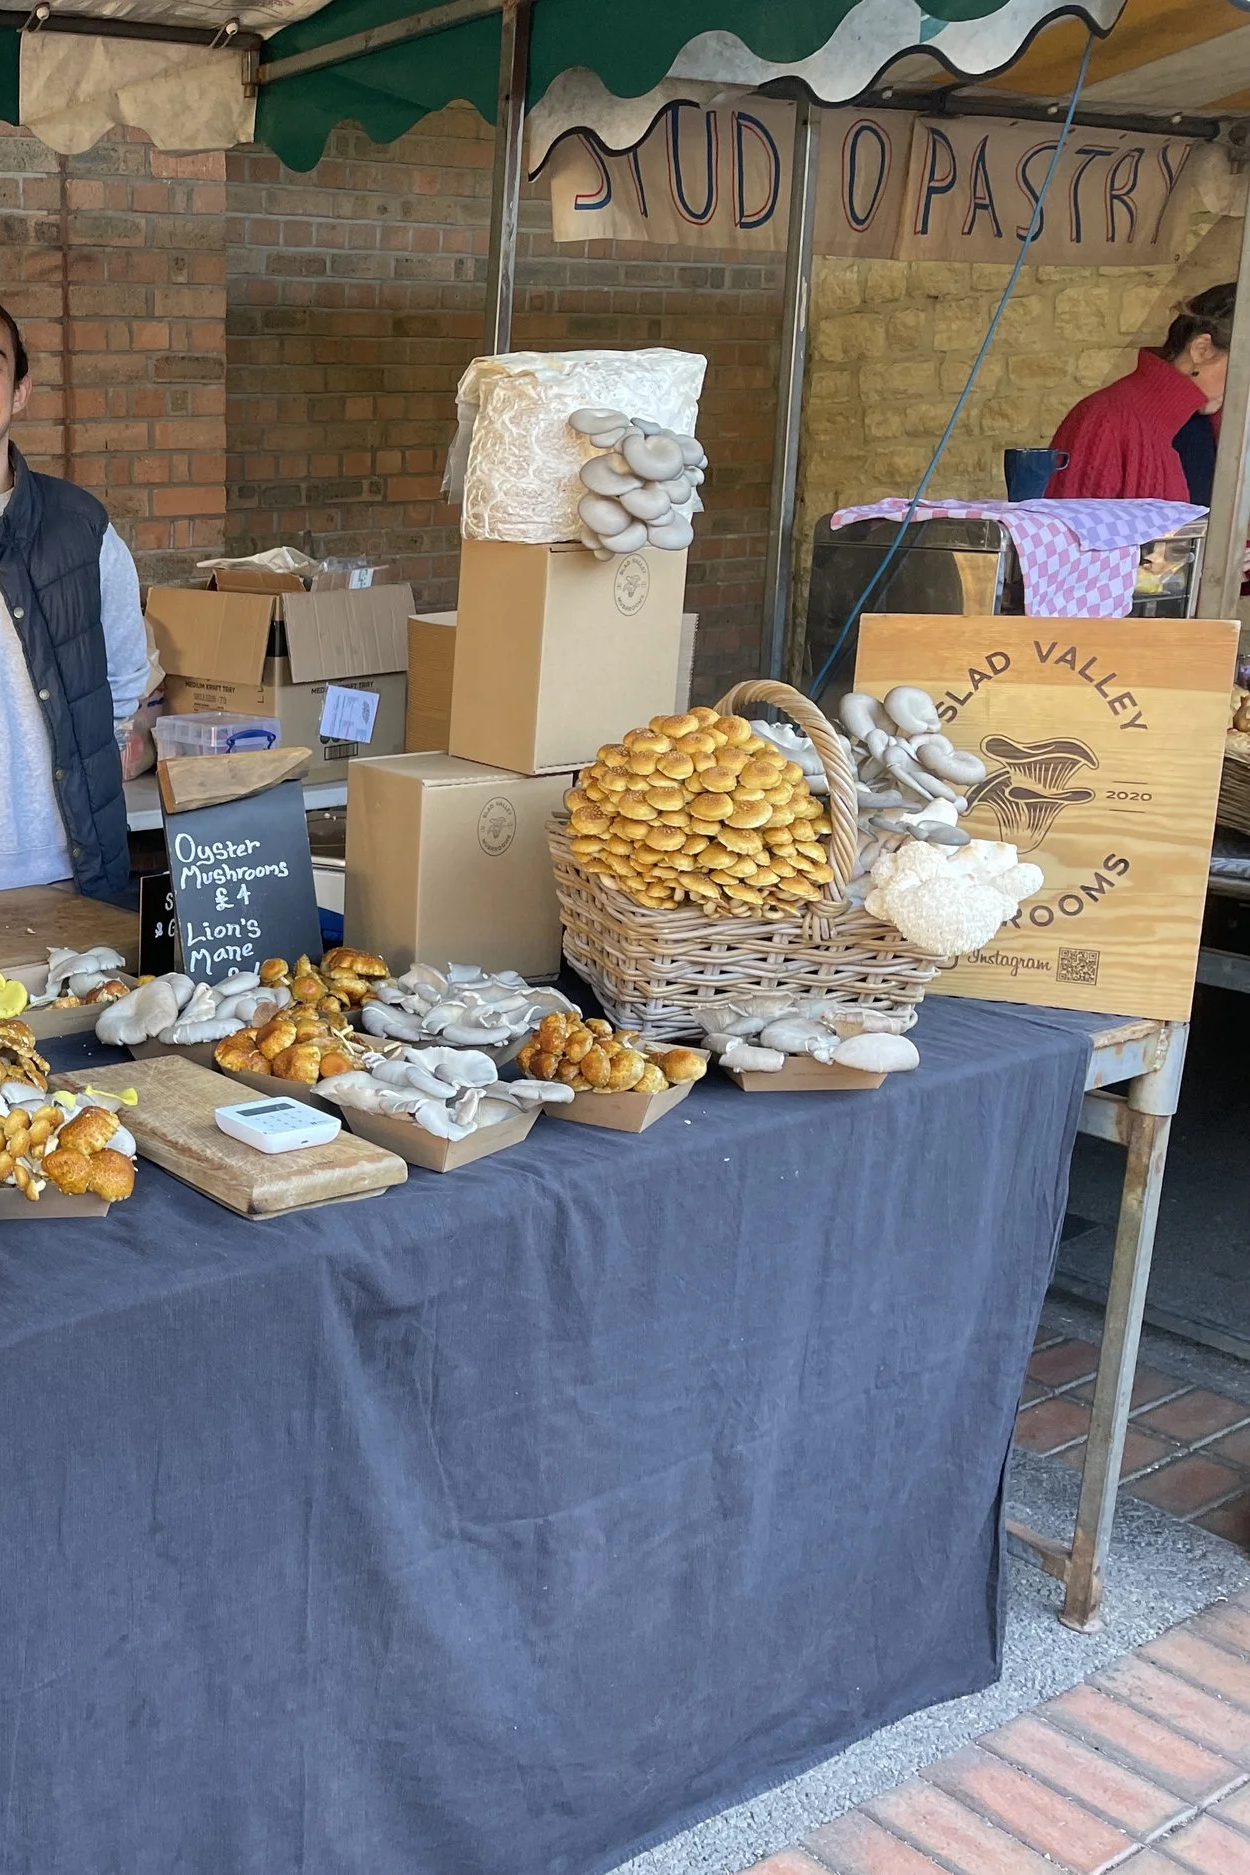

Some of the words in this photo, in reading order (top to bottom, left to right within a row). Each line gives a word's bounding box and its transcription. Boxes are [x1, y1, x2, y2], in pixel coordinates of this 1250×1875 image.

[914, 126, 1193, 245] PASTRY
[935, 651, 1011, 724] SLAD
[1033, 640, 1148, 730] VALLEY
[1104, 790, 1153, 802] 2020
[174, 833, 261, 866] Oyster
[180, 861, 289, 890] Mushrooms
[187, 918, 262, 946] Lion's
[190, 942, 255, 976] Mane
[967, 949, 1052, 977] Instagram
